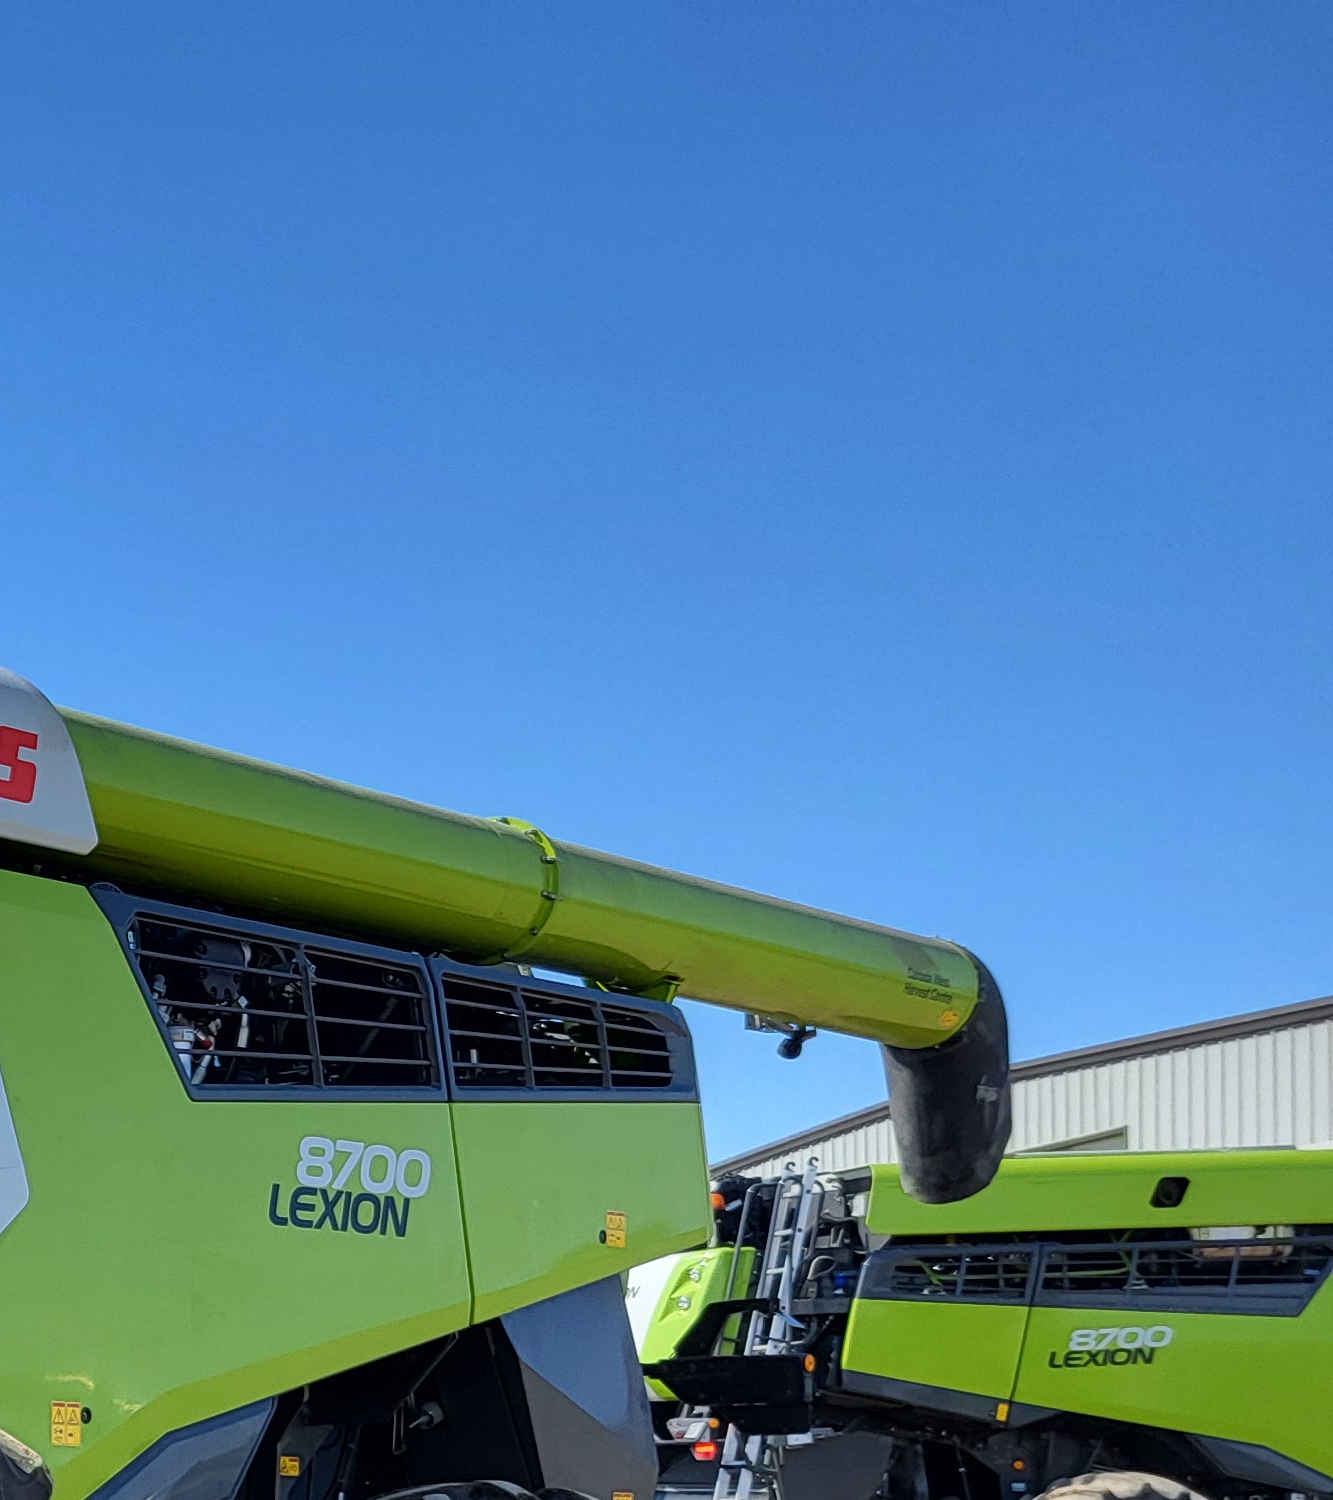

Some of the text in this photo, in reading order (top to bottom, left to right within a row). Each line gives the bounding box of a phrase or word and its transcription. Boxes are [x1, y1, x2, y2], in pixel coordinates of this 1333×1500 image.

[296, 1136, 432, 1198] 8700
[268, 1183, 410, 1238] LEXION
[1068, 1325, 1174, 1351] 8700
[1048, 1348, 1155, 1369] LEXION
